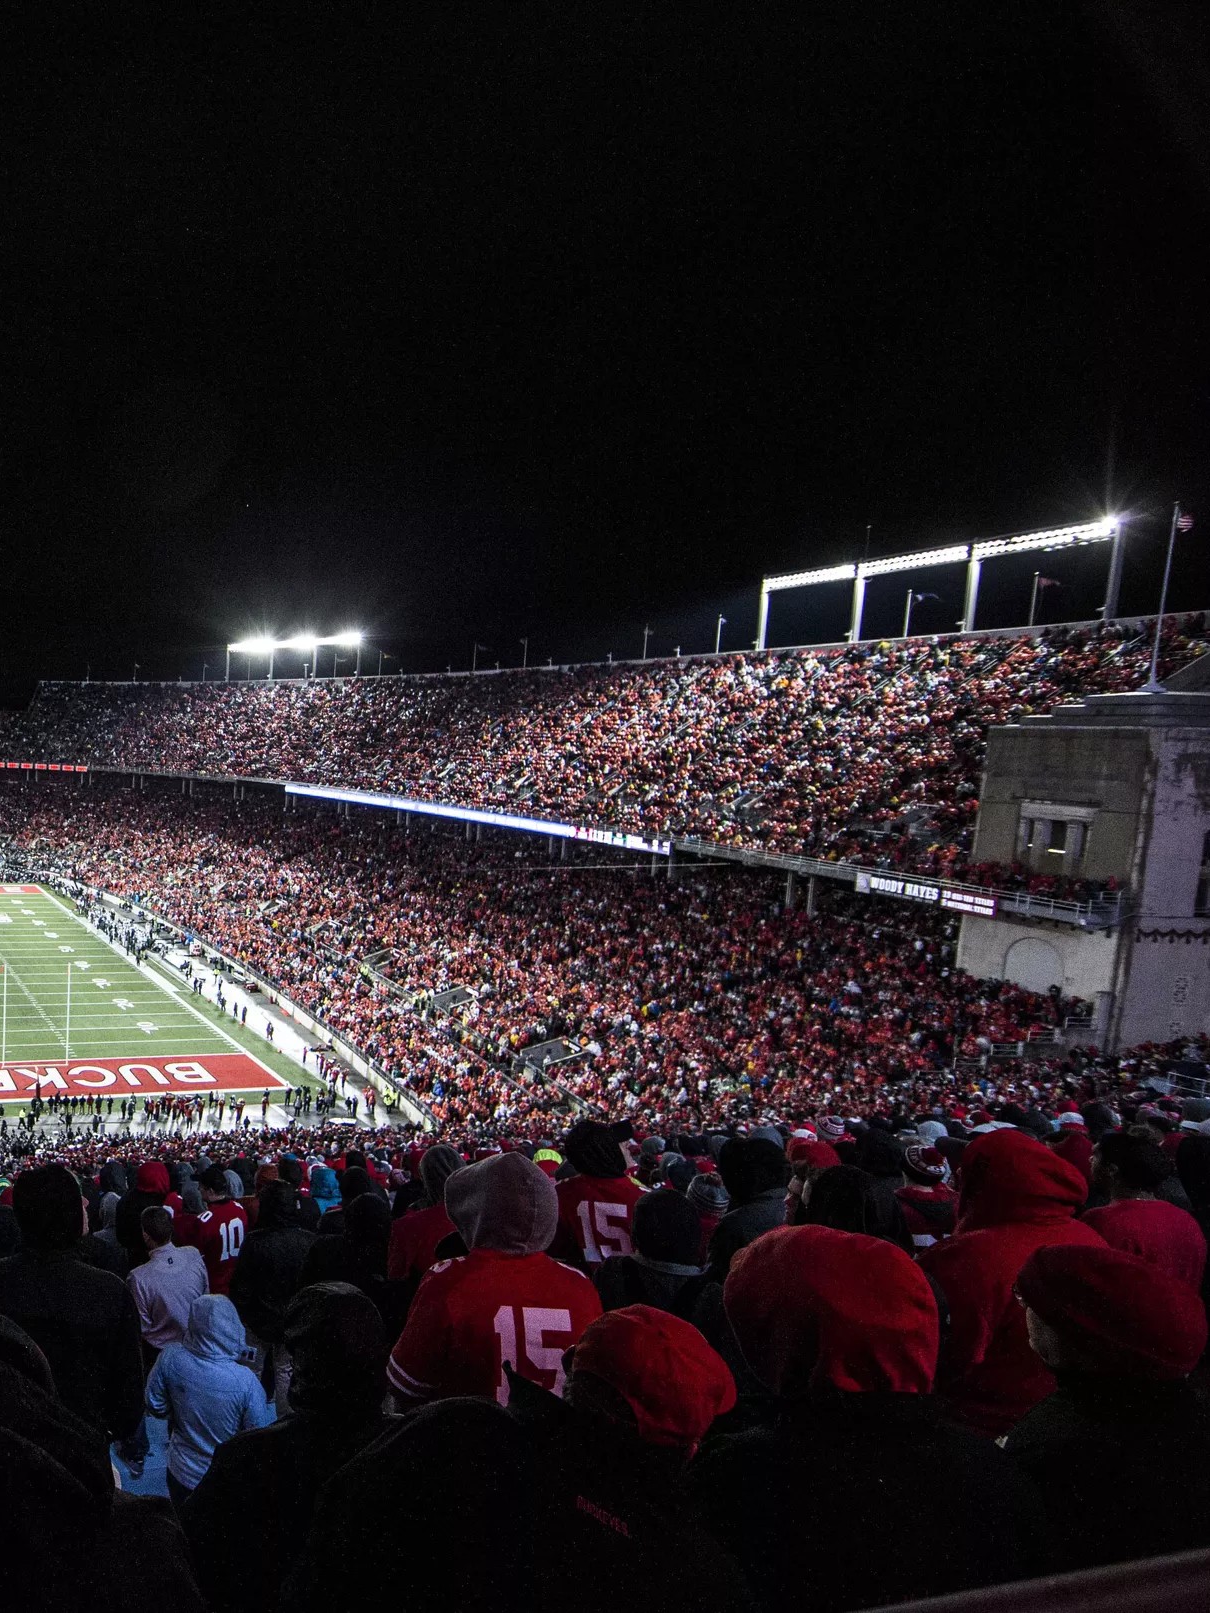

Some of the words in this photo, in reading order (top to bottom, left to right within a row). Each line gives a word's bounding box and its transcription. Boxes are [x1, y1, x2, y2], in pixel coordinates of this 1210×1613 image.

[870, 877, 905, 894] WOODY
[905, 883, 939, 900] HAYES
[219, 1217, 244, 1261] 10
[577, 1200, 632, 1262] 15
[493, 1305, 572, 1408] 15
